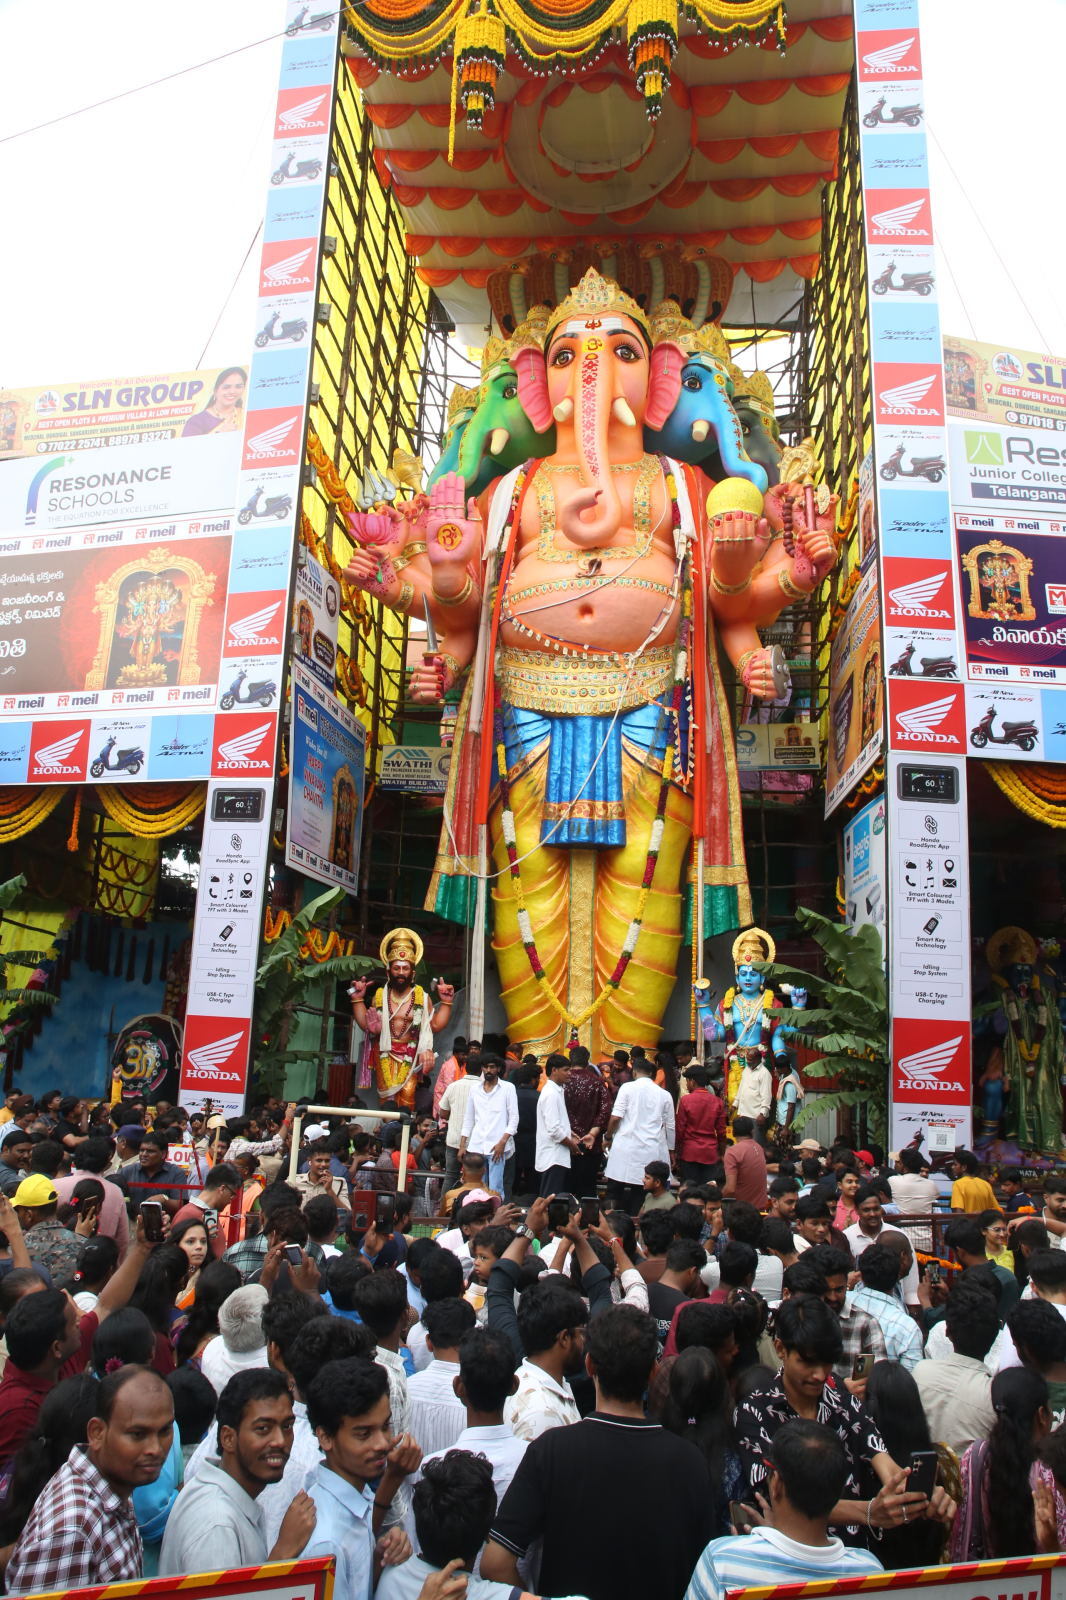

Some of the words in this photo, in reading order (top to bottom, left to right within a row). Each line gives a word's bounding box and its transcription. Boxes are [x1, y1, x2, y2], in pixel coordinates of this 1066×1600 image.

[864, 66, 919, 75] HONDA
[278, 120, 326, 131] HONDA
[872, 228, 930, 236] HONDA
[262, 276, 311, 288] HONDA
[63, 388, 112, 412] SLN
[116, 380, 204, 408] GROUP
[1002, 386, 1020, 396] BEST
[1022, 389, 1040, 400] OPEN
[1042, 392, 1065, 404] PLOTS
[880, 407, 940, 416] HONDA
[72, 417, 90, 425] PLOTS
[1019, 413, 1053, 428] 97018
[48, 441, 76, 452] 77022
[142, 430, 172, 442] 93274
[246, 449, 296, 460] HONDA
[50, 466, 172, 494] RESONANCE
[970, 466, 1016, 480] Junior
[1022, 469, 1066, 486] Colleg
[48, 488, 135, 512] SCHOOLS
[48, 514, 62, 524] THE
[64, 510, 102, 522] EQUATION
[104, 508, 118, 518] FOR
[120, 503, 168, 516] EXCELLENCE
[203, 520, 230, 532] meil
[972, 518, 994, 527] meil
[1018, 521, 1040, 530] meil
[97, 530, 123, 544] meil
[150, 525, 176, 538] meil
[46, 536, 71, 548] meil
[56, 592, 65, 602] &
[890, 607, 952, 618] HONDA
[227, 636, 280, 648] HONDA
[985, 666, 1009, 676] meil
[1032, 668, 1056, 678] meil
[72, 694, 98, 706] meil
[126, 691, 154, 704] meil
[182, 688, 211, 700] meil
[18, 697, 44, 709] meil
[305, 708, 318, 728] meil
[896, 731, 960, 744] HONDA
[217, 760, 270, 770] HONDA
[384, 760, 432, 768] SWATHI
[33, 766, 82, 775] HONDA
[854, 831, 870, 860] aegis
[915, 942, 946, 950] Technology
[186, 1070, 242, 1081] HONDA
[898, 1080, 966, 1092] HONDA
